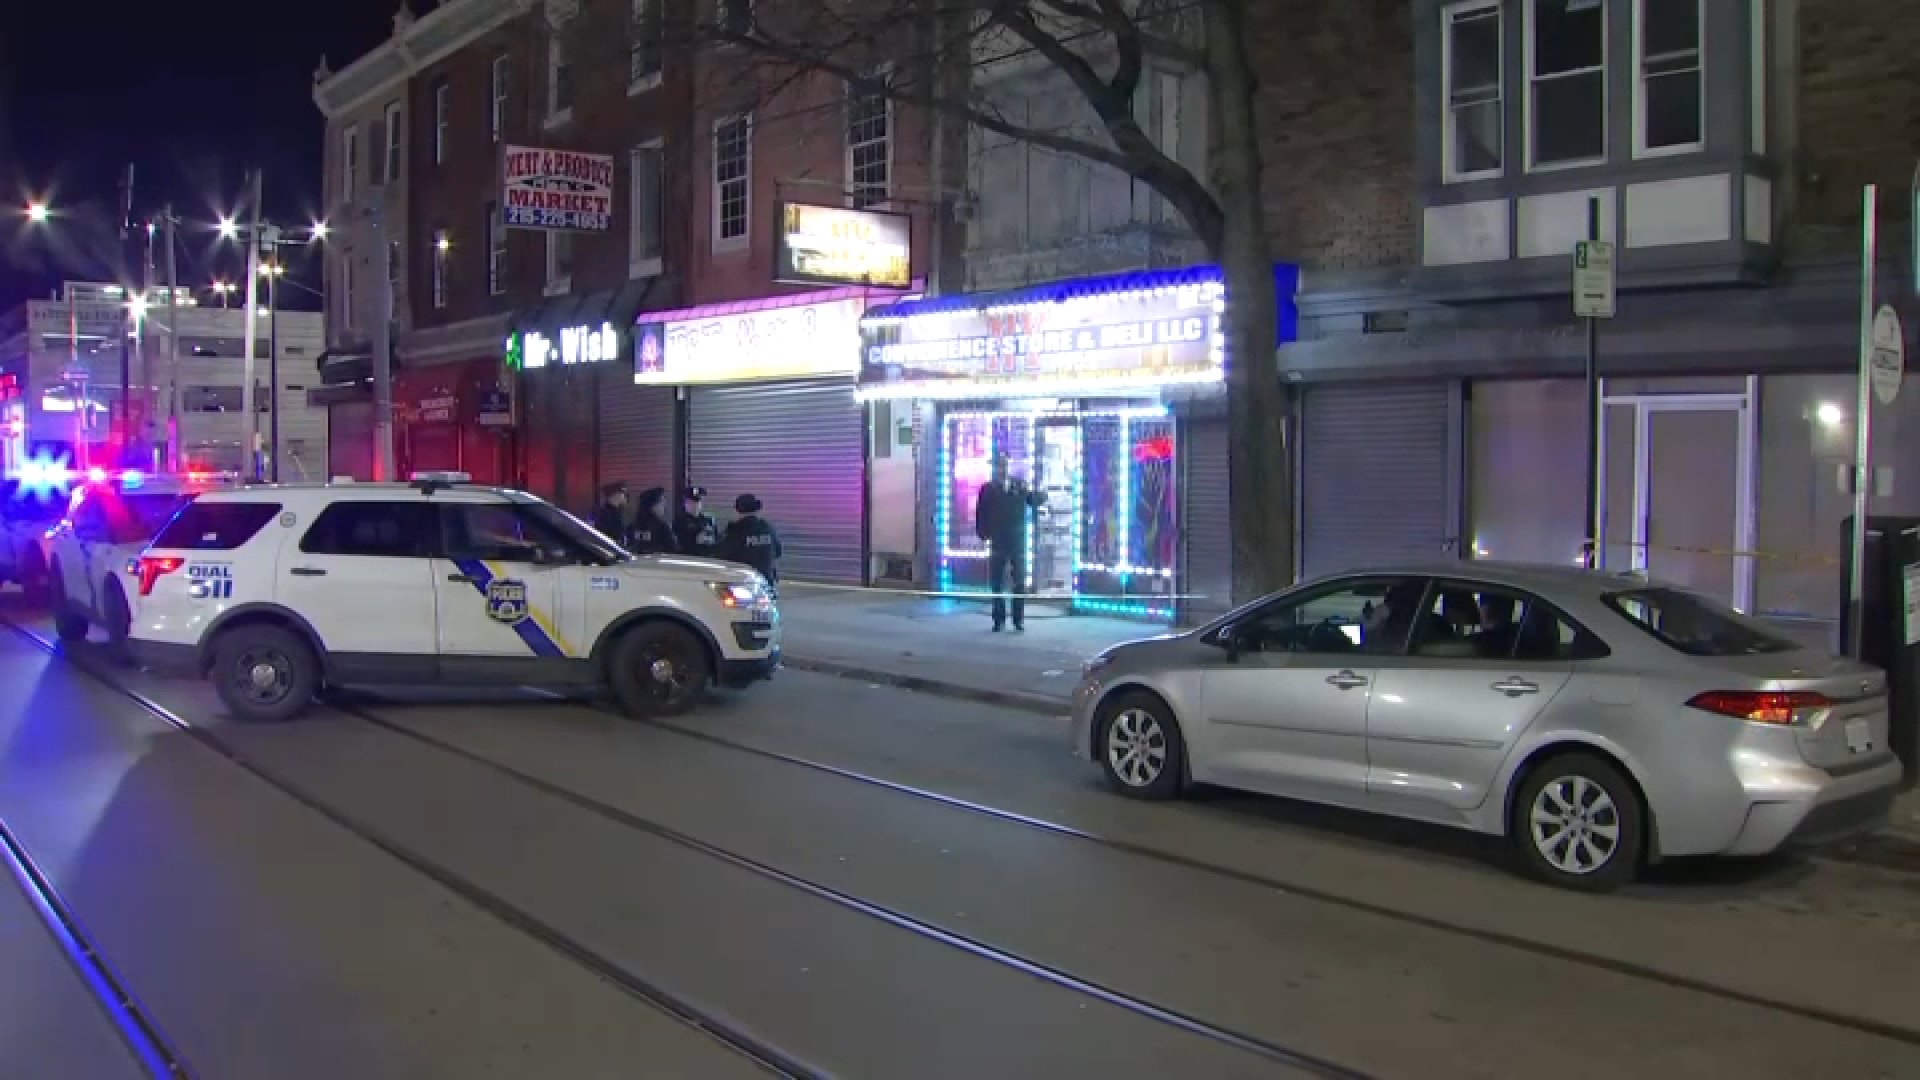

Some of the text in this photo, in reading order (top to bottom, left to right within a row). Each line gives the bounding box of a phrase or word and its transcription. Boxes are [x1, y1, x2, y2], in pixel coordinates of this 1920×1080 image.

[542, 152, 552, 175] &
[554, 152, 612, 188] PRODUCE
[509, 189, 608, 213] MARKET
[560, 320, 619, 365] Wish
[1002, 330, 1073, 356] STORE
[1076, 330, 1096, 350] &
[1100, 321, 1153, 348] DELI
[1157, 318, 1202, 342] LLC
[189, 565, 233, 578] DIAL
